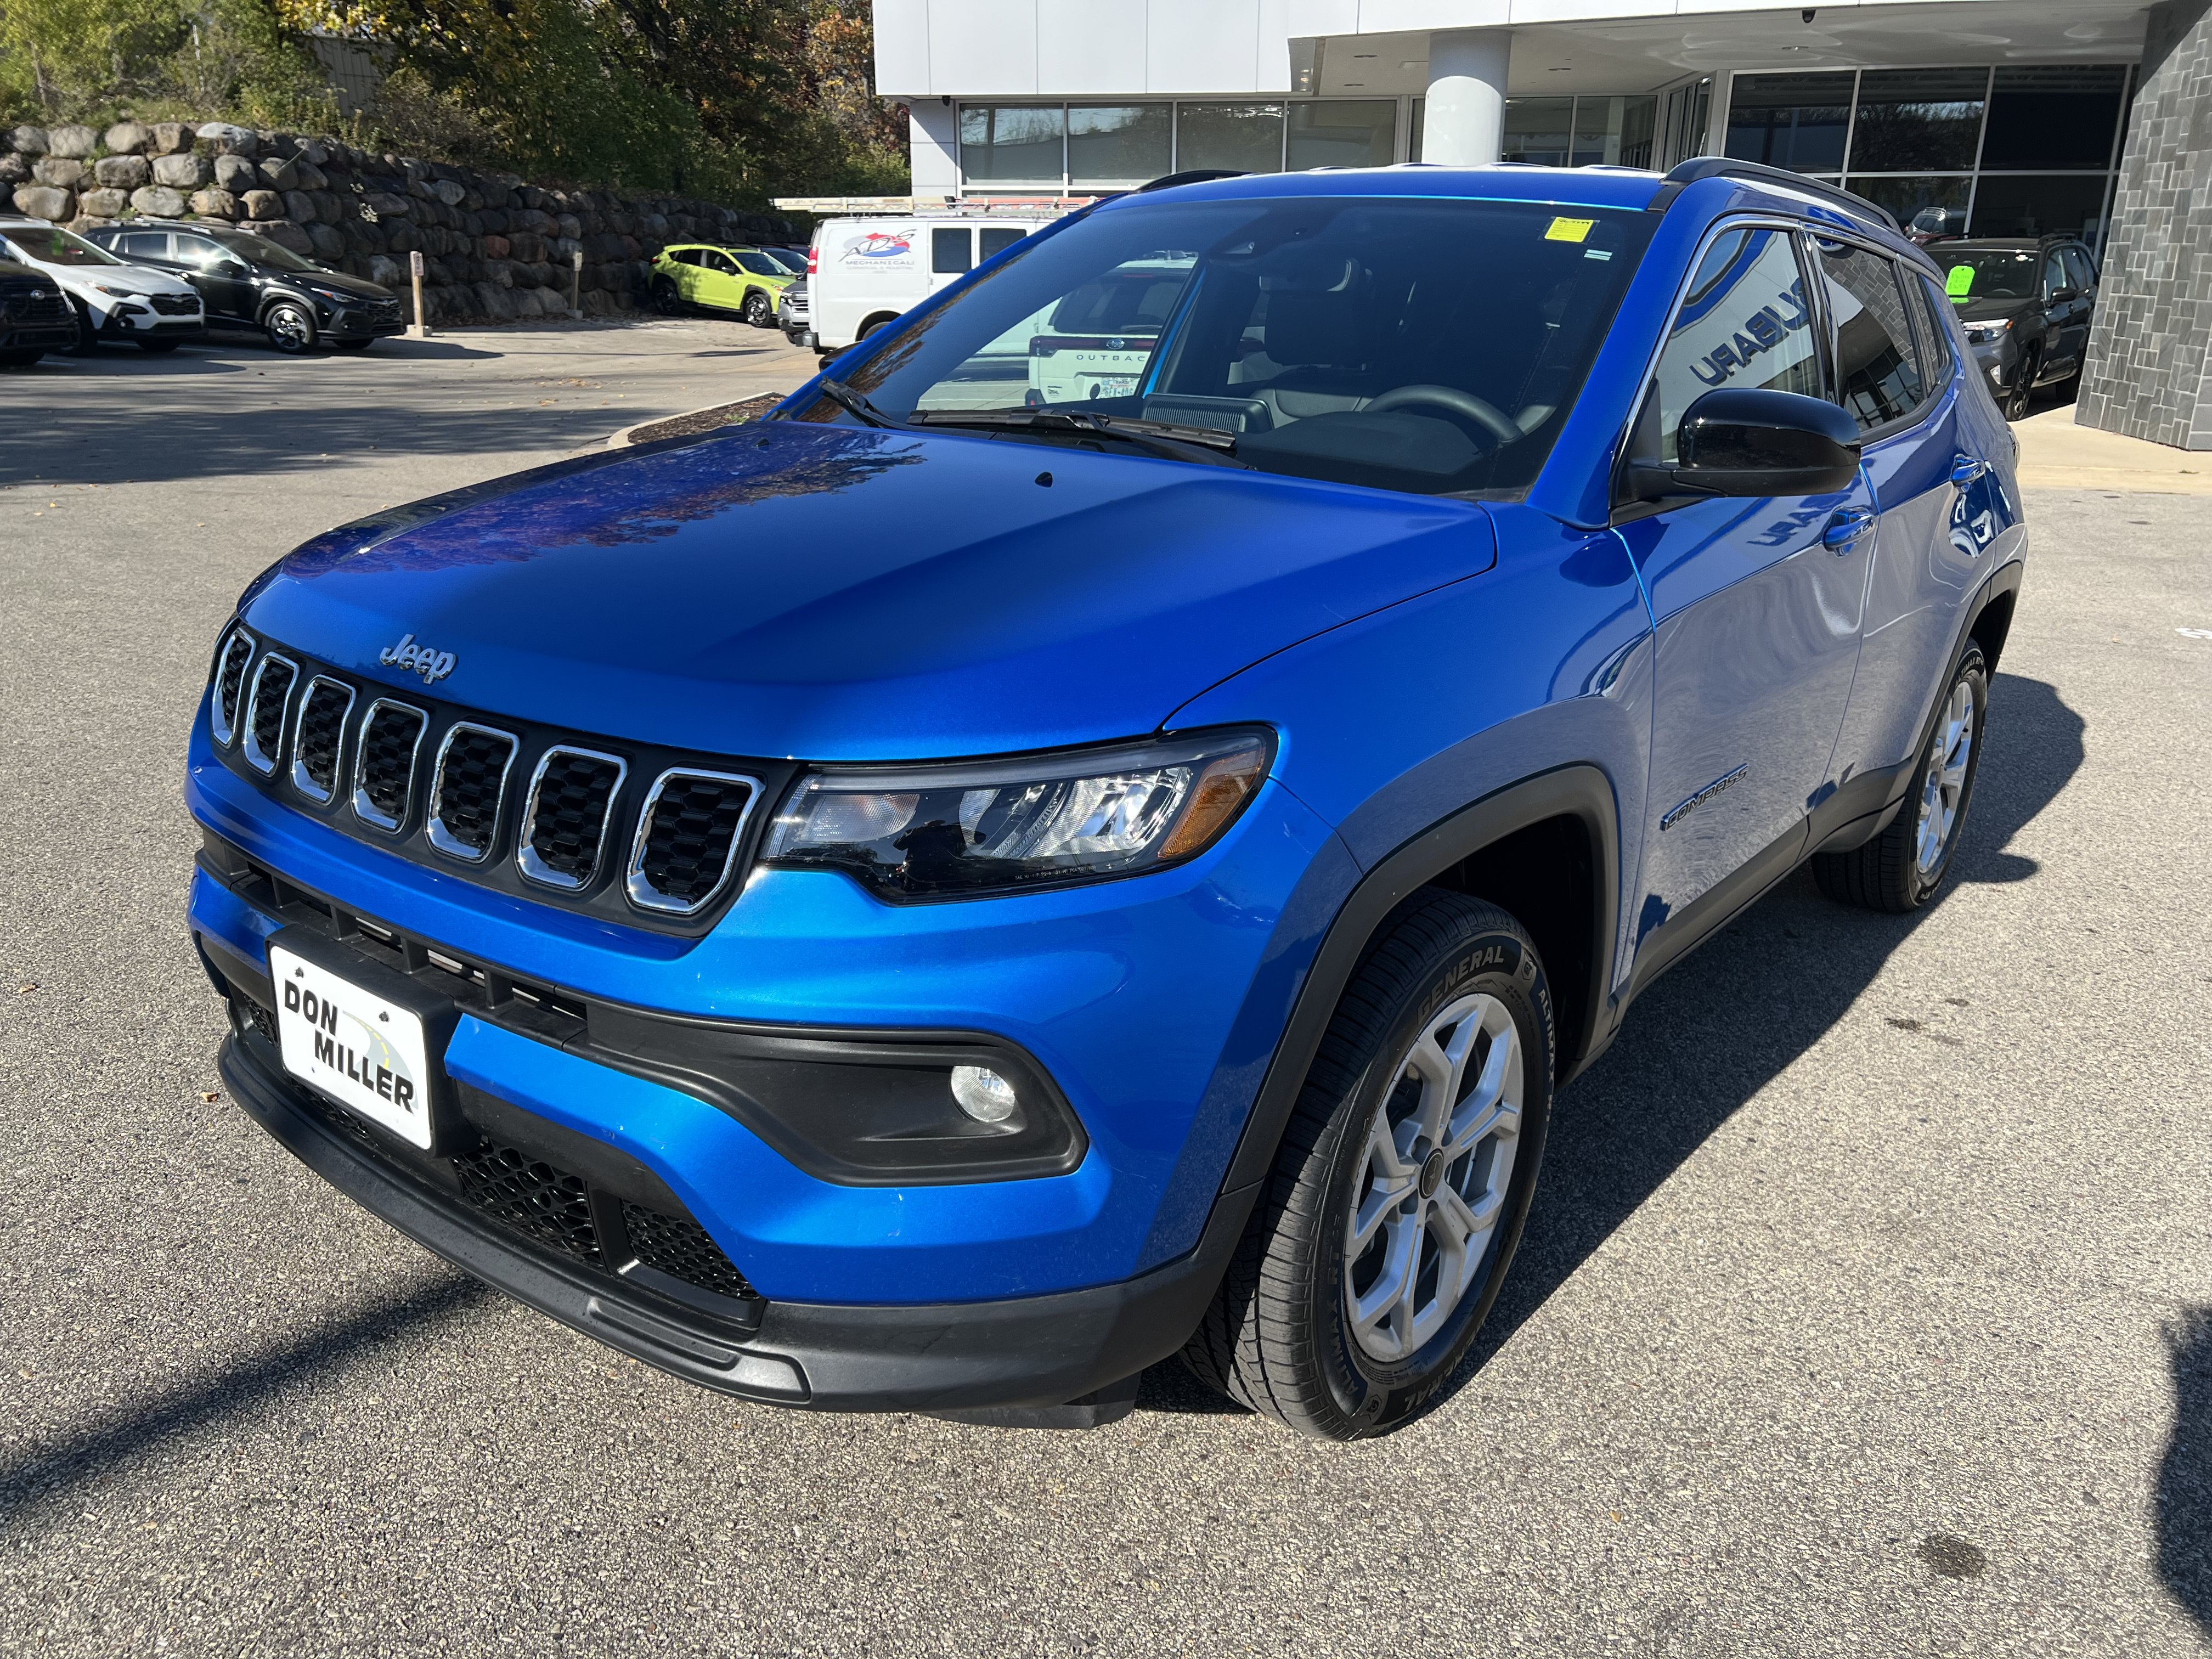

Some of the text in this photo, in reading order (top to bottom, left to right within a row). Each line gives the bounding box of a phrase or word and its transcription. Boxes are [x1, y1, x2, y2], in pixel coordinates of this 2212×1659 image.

[839, 229, 917, 262] ADS
[380, 634, 457, 685] Jeep
[1660, 763, 1749, 832] COMPASS
[284, 978, 338, 1036] DON
[1417, 945, 1504, 1025] GENERAL
[314, 1029, 414, 1115] MILLER
[1538, 989, 1554, 1084] ALTIMAX
[1327, 1298, 1359, 1396] ALTIMAX
